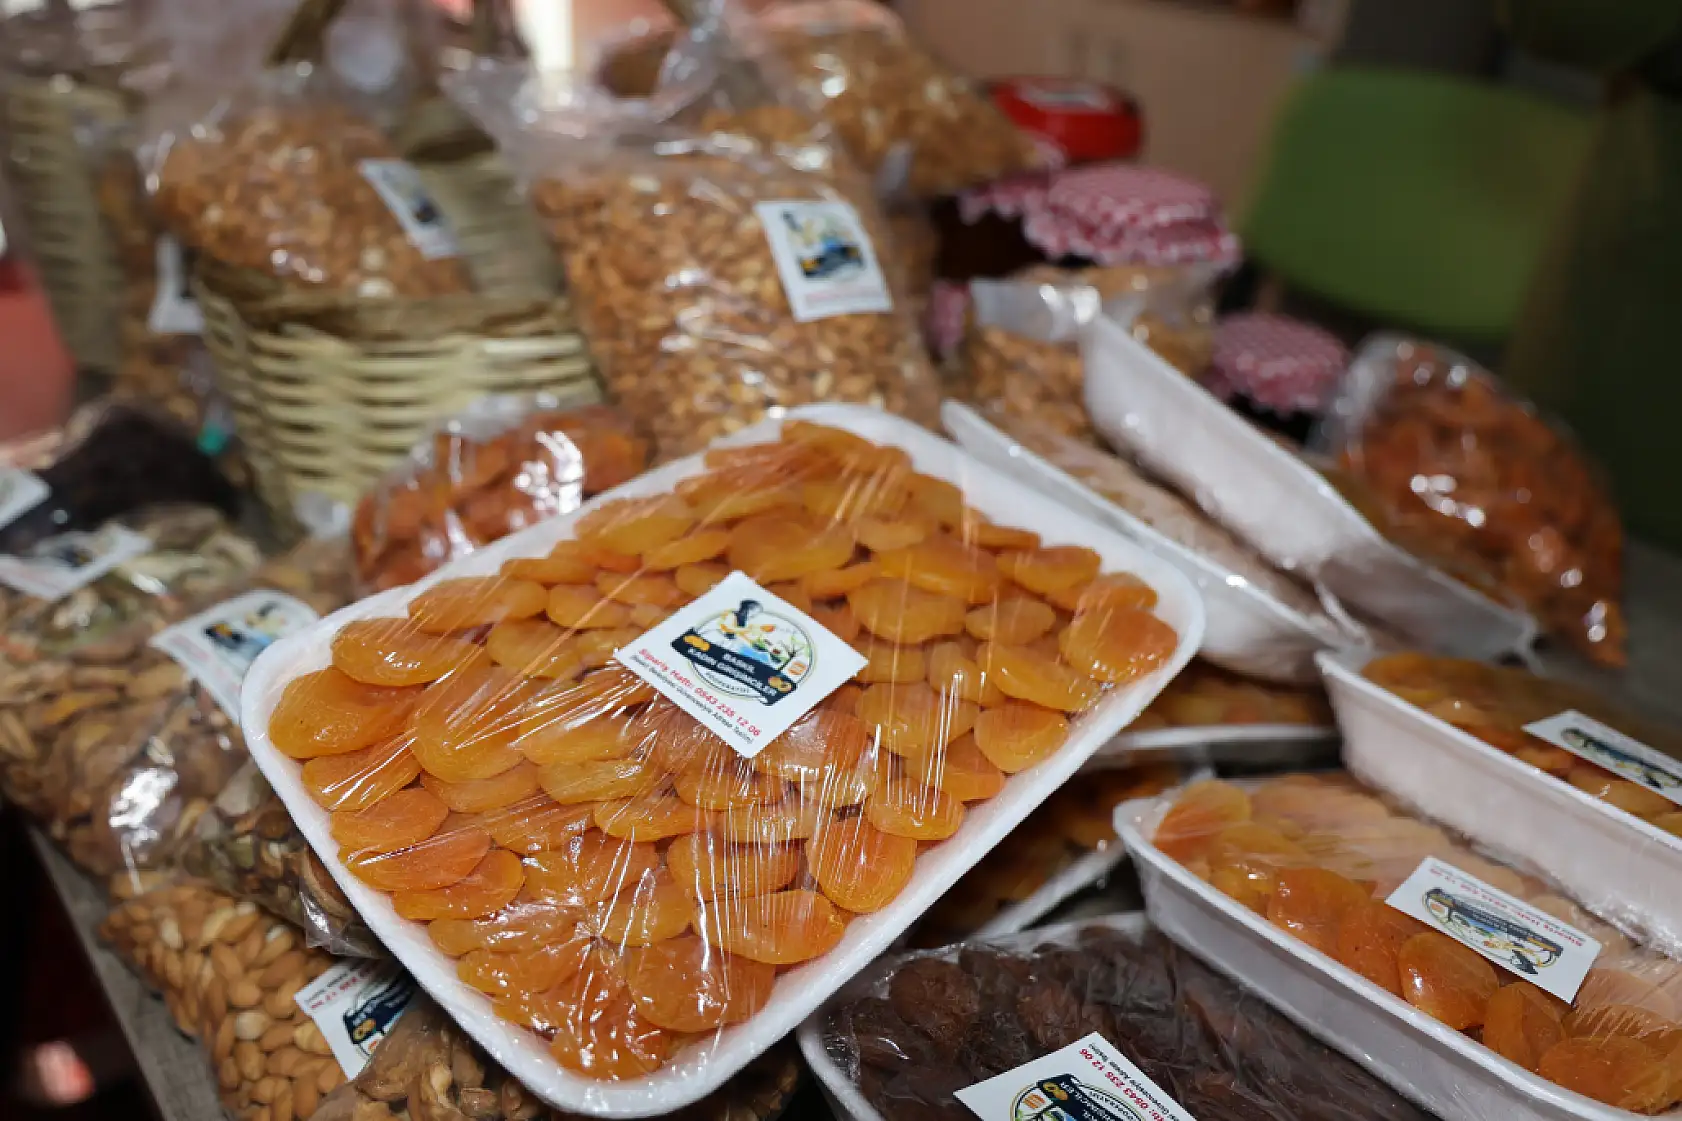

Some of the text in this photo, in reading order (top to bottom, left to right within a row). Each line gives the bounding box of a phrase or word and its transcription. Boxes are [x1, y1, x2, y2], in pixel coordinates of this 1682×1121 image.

[694, 687, 719, 705] 0543
[736, 716, 749, 727] 12
[748, 724, 761, 737] 06
[1080, 1048, 1094, 1060] 06
[1091, 1060, 1105, 1071] 12
[1105, 1071, 1125, 1088] 235
[1123, 1088, 1149, 1110] 0543
